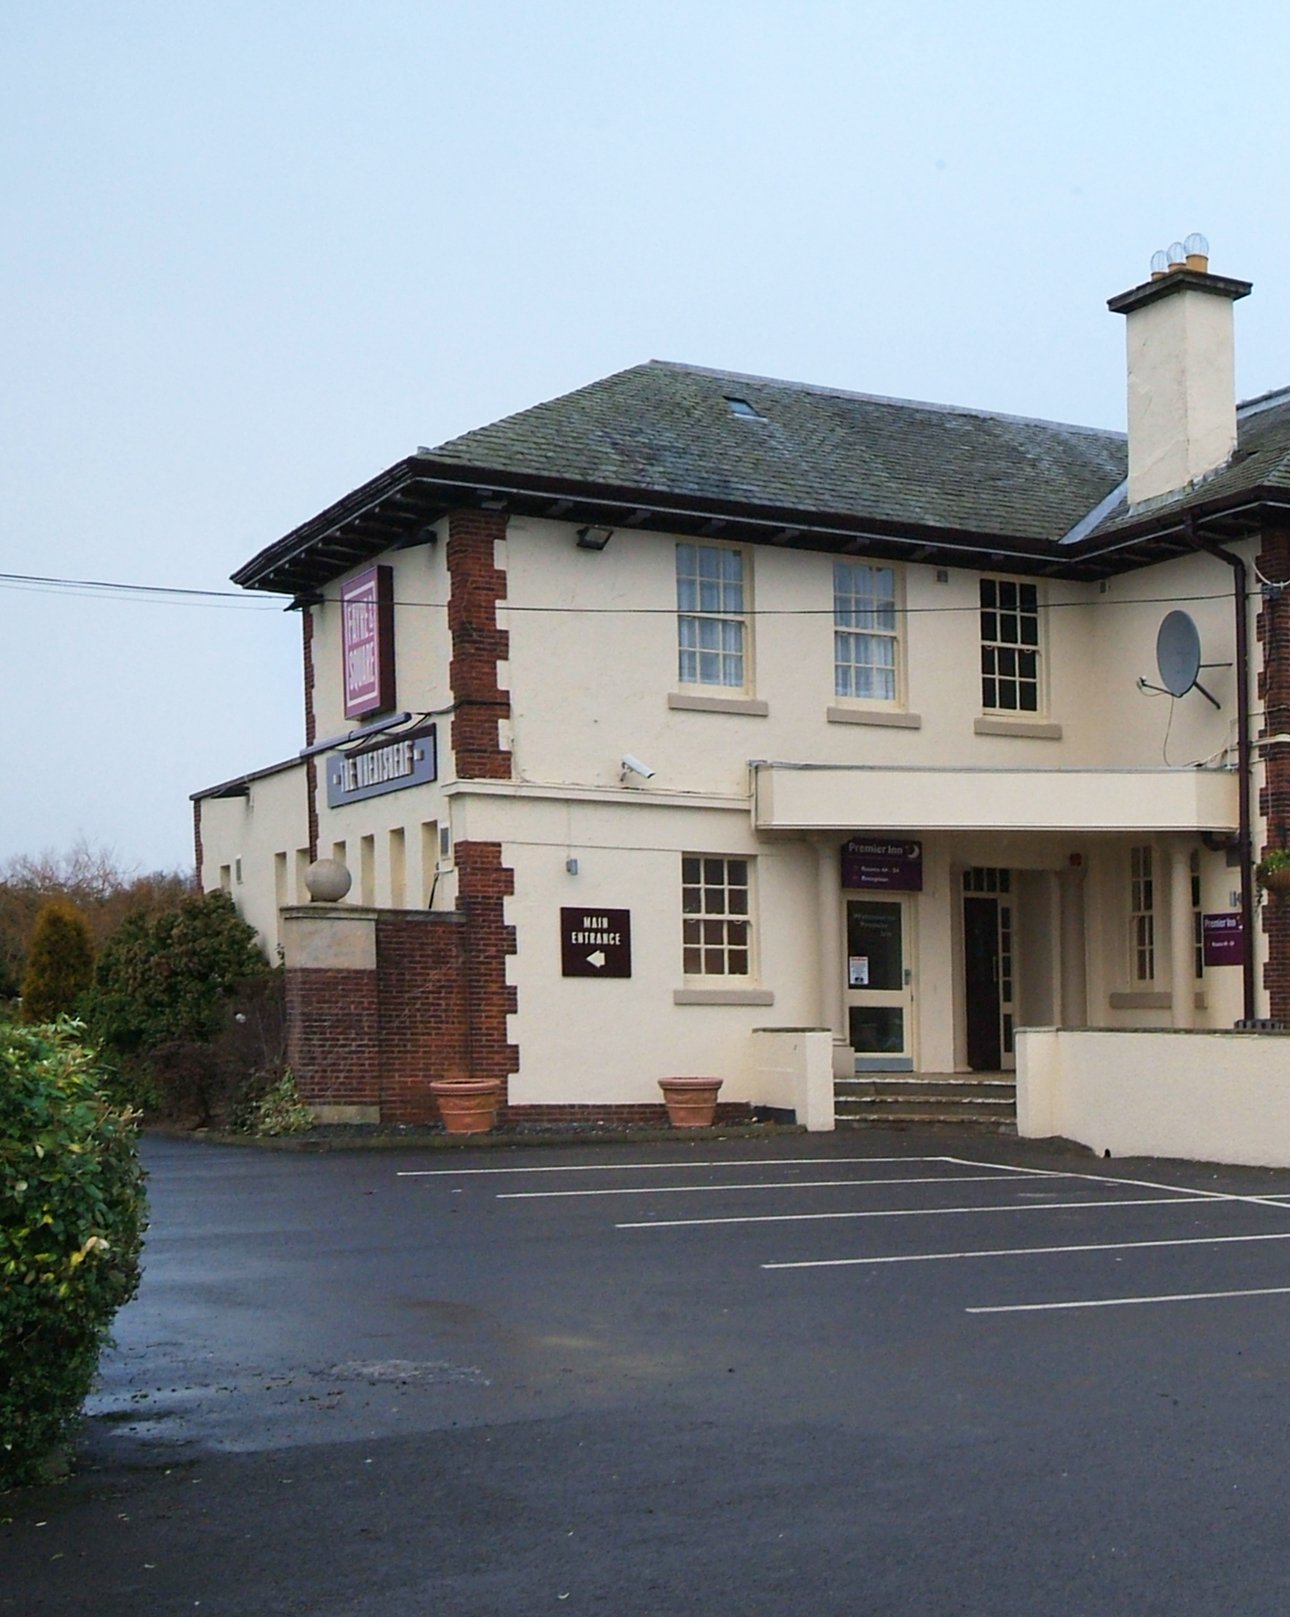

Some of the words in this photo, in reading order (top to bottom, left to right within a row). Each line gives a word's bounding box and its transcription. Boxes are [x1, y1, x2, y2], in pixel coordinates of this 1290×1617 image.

[848, 841, 886, 854] Premier
[887, 844, 904, 855] Inn
[583, 916, 609, 929] MAIN
[571, 931, 621, 945] ENTRANCE
